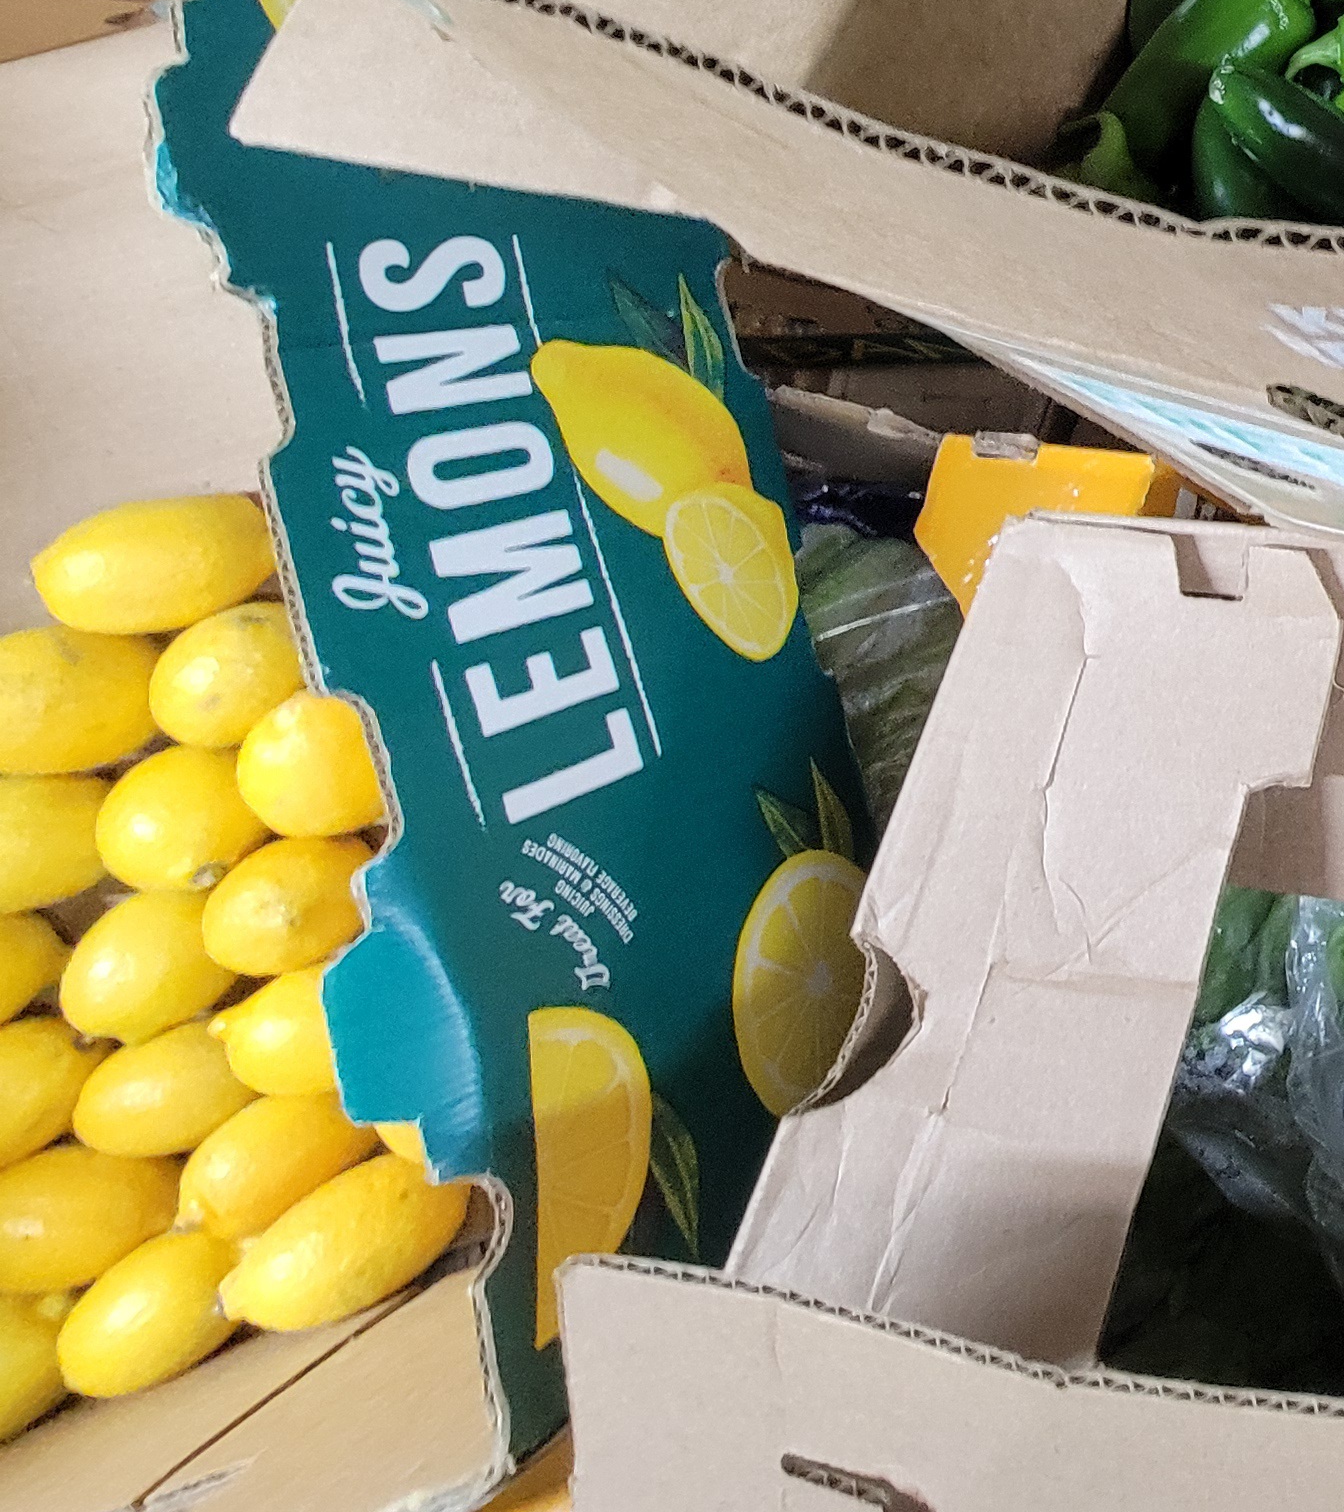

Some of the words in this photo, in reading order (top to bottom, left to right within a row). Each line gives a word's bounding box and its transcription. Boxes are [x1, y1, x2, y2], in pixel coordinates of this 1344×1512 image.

[329, 444, 430, 621] Juicy
[358, 233, 646, 826] LEMONS
[521, 838, 583, 885] MARINADES
[546, 832, 599, 877] FLAVORING
[499, 879, 555, 932] For
[555, 878, 597, 918] JUICING
[589, 887, 634, 945] DRESSINGS
[595, 869, 638, 923] BEVERAGE
[550, 913, 611, 991] Great
